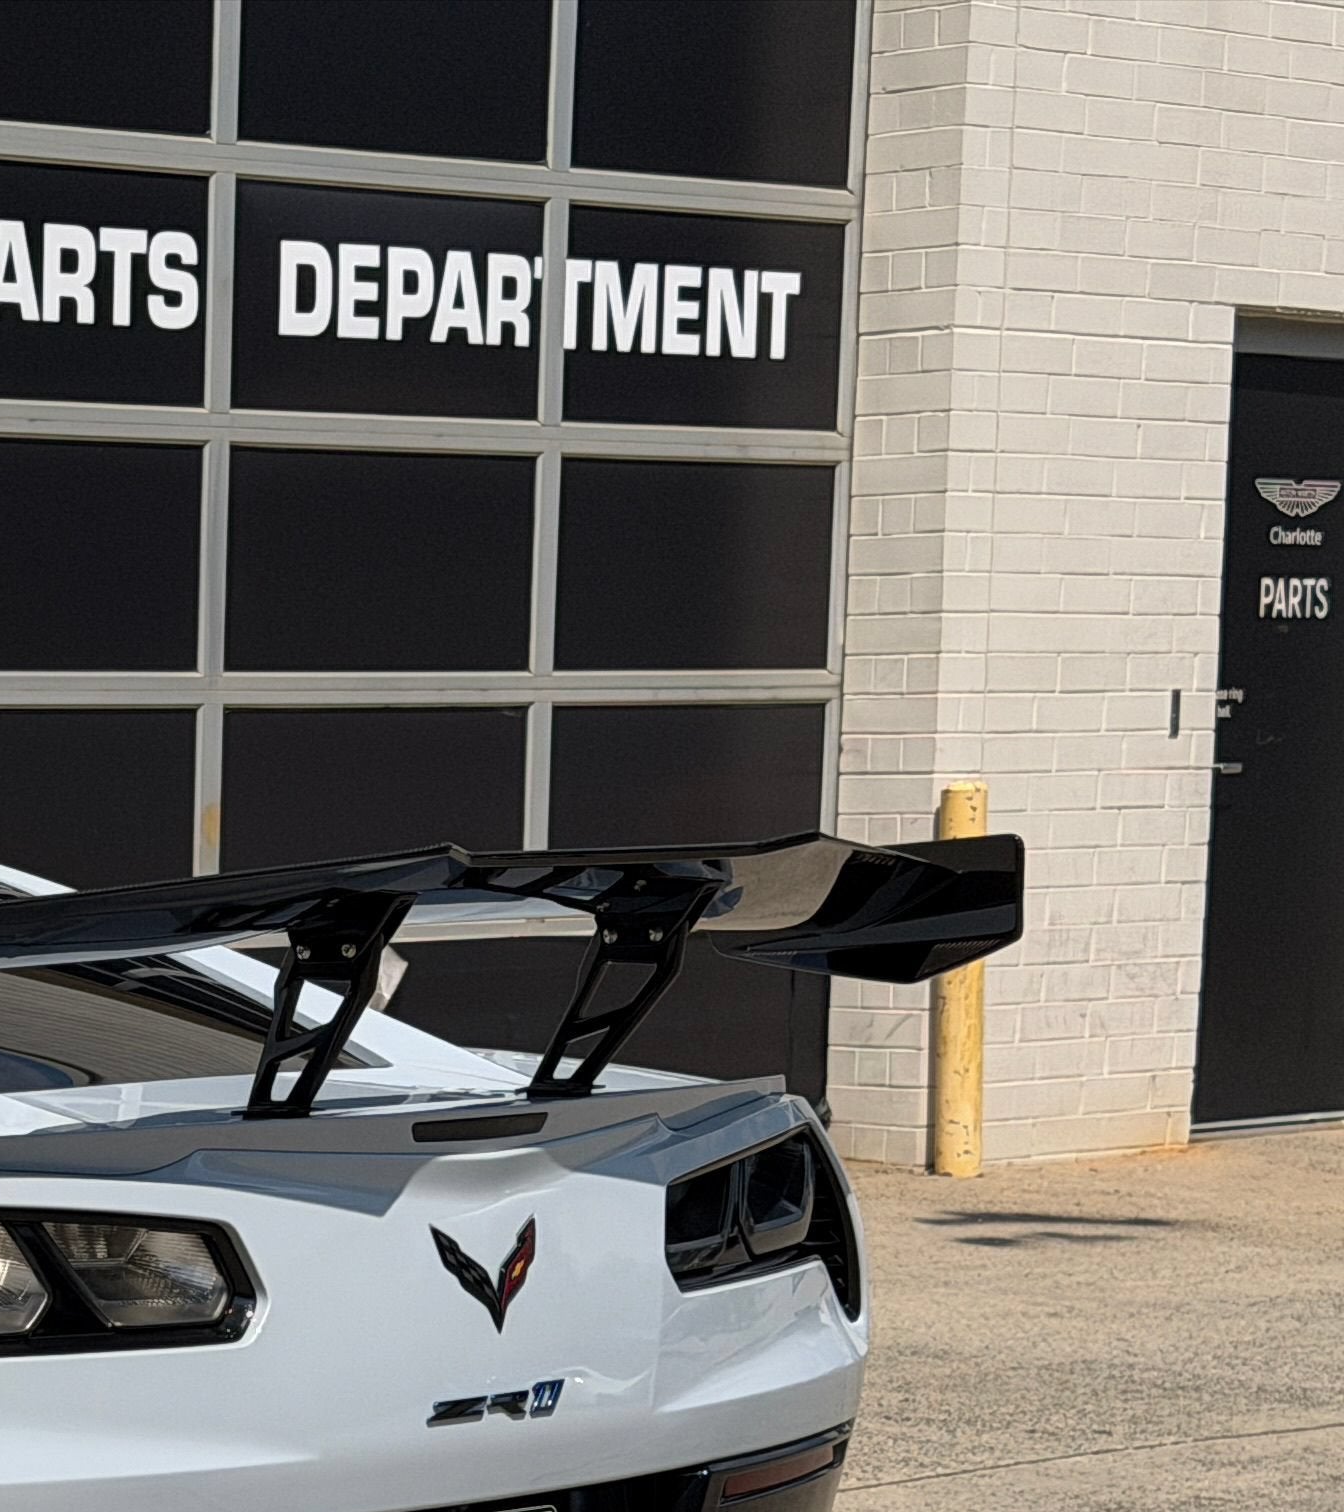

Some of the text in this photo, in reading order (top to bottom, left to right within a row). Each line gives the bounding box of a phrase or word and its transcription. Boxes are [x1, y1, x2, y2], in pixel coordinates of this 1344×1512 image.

[278, 239, 802, 361] DEPARTMENT
[1269, 525, 1323, 546] Charlotte
[1258, 576, 1330, 620] PARTS
